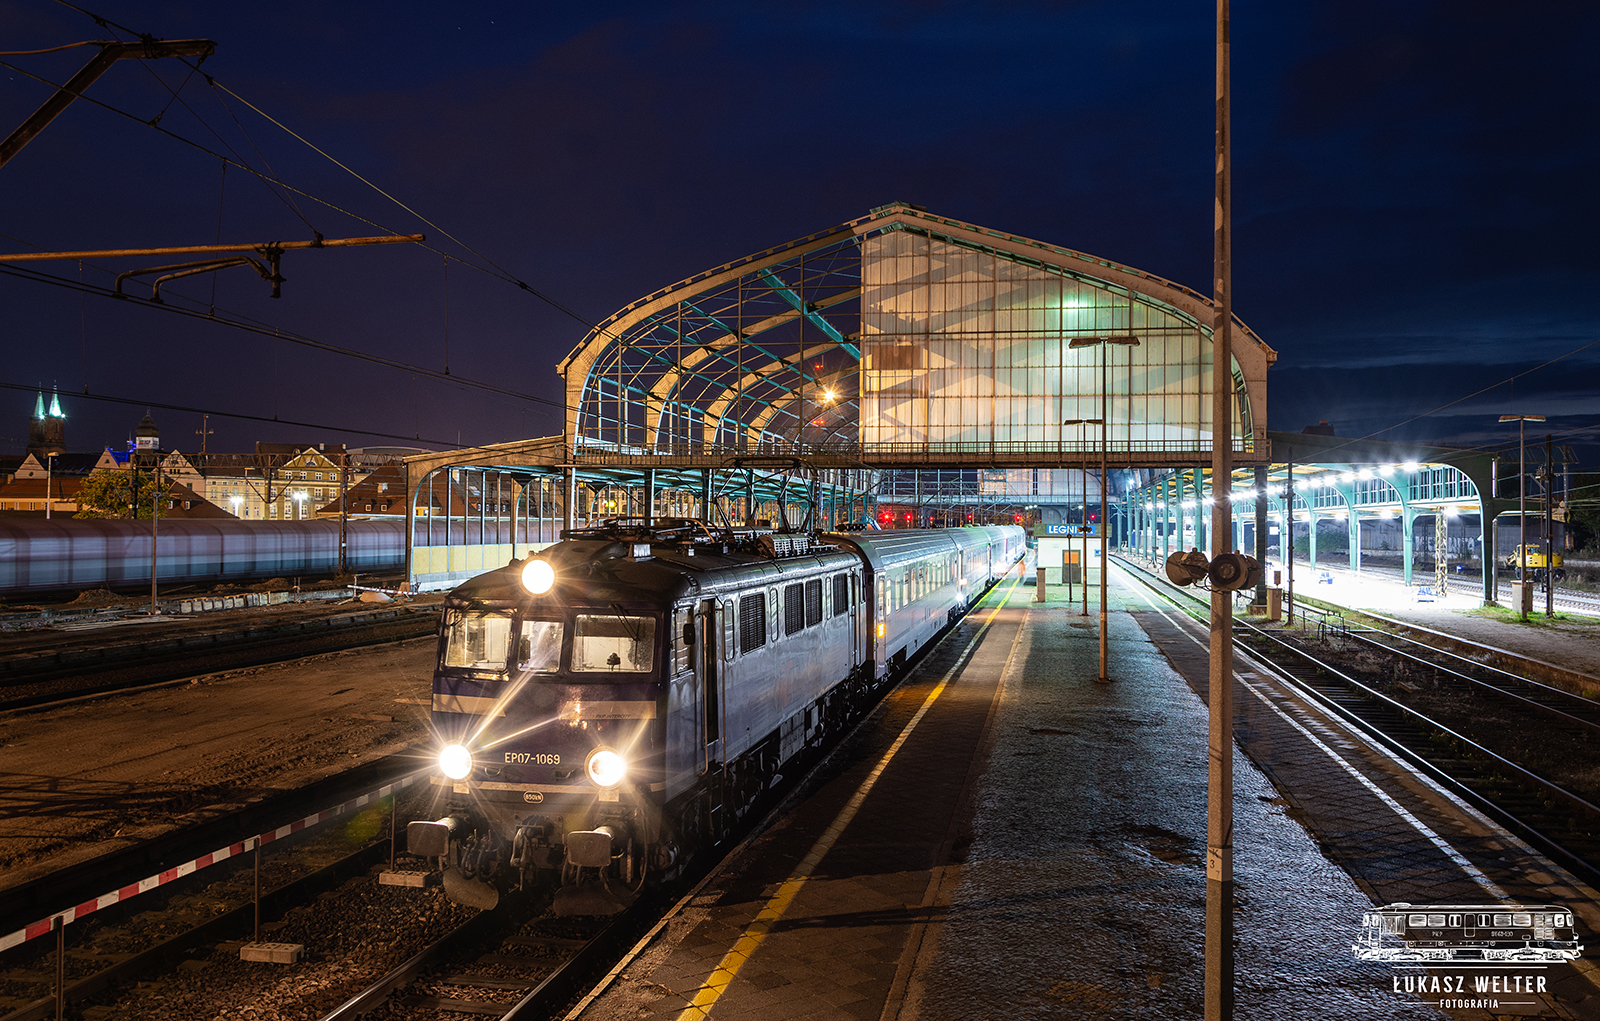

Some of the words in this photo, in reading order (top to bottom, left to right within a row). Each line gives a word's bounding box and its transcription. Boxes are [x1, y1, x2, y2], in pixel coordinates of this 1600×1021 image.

[1048, 525, 1093, 534] LEGNI
[504, 752, 561, 765] EP07-1069
[1210, 859, 1215, 869] 3
